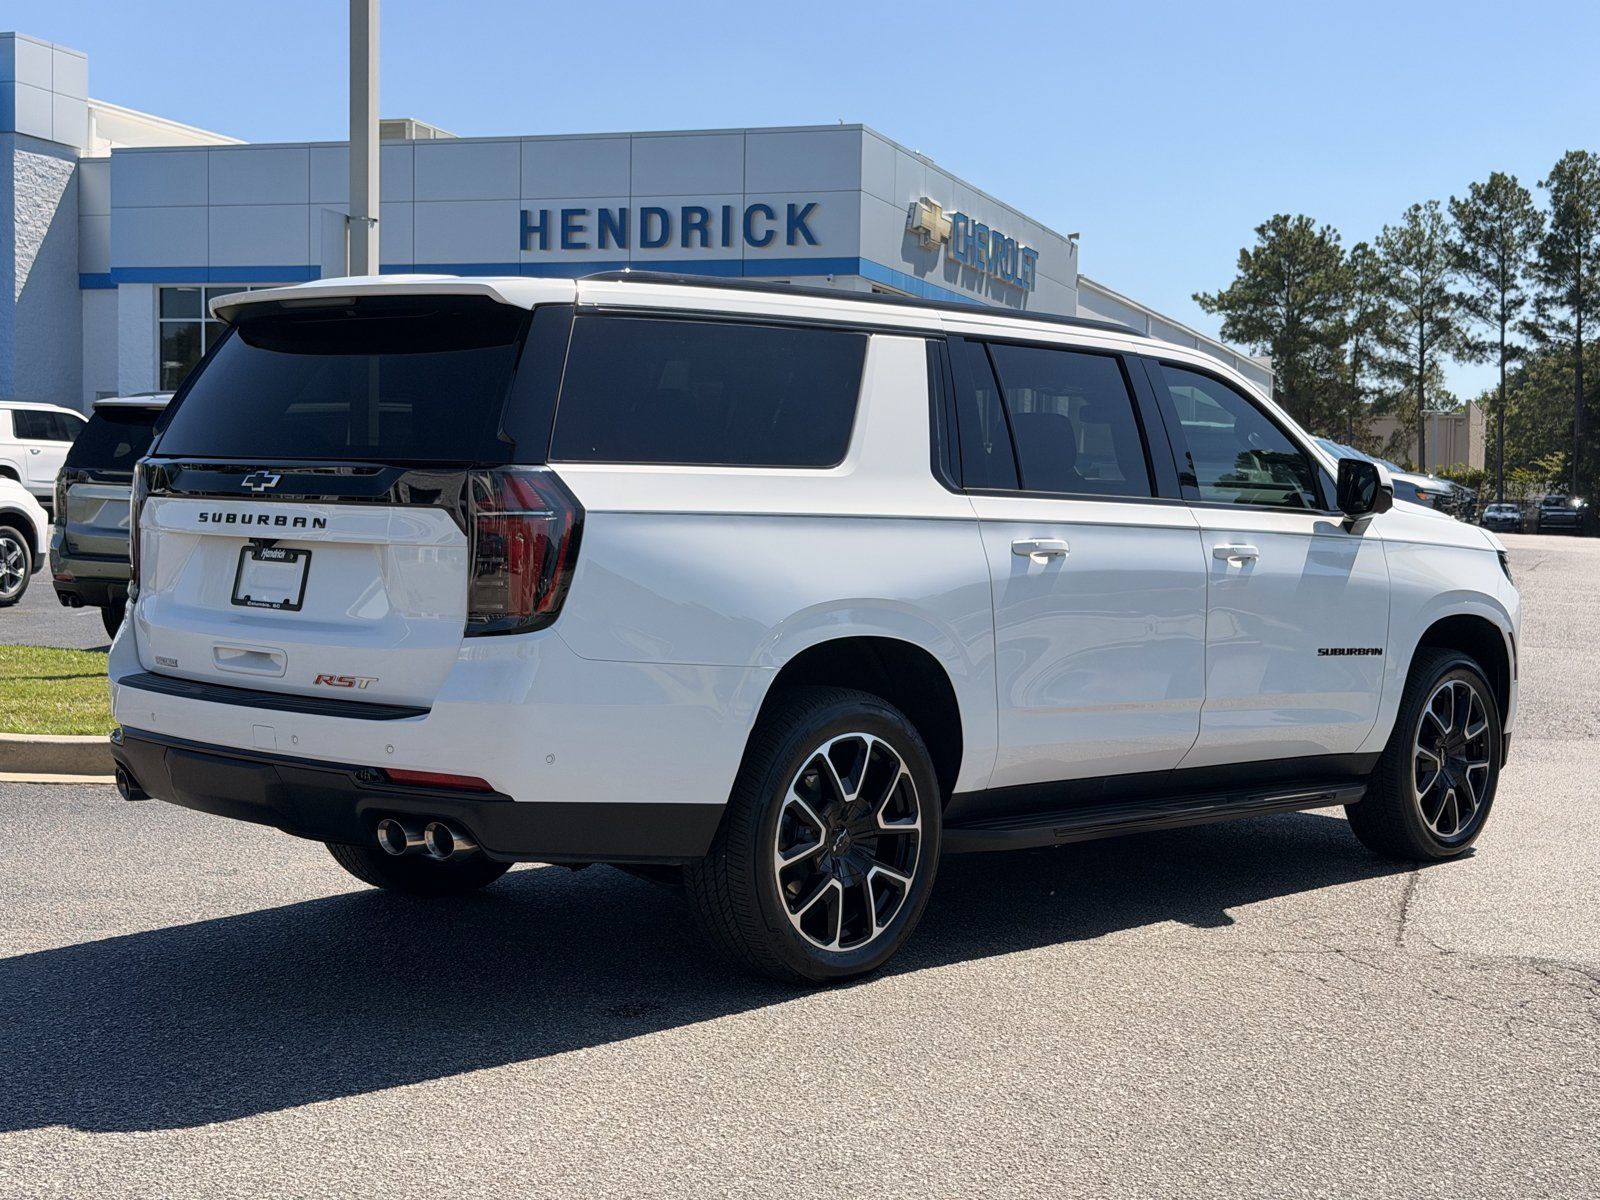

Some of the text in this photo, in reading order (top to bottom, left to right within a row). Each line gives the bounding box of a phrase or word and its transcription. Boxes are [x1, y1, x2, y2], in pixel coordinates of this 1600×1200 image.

[519, 202, 819, 250] HENDRICK
[950, 210, 1039, 292] CHEVROLET
[198, 512, 327, 529] SUBURBAN
[260, 548, 286, 559] Hendrick
[1317, 647, 1383, 657] SUBURBAN
[313, 674, 379, 690] RST
